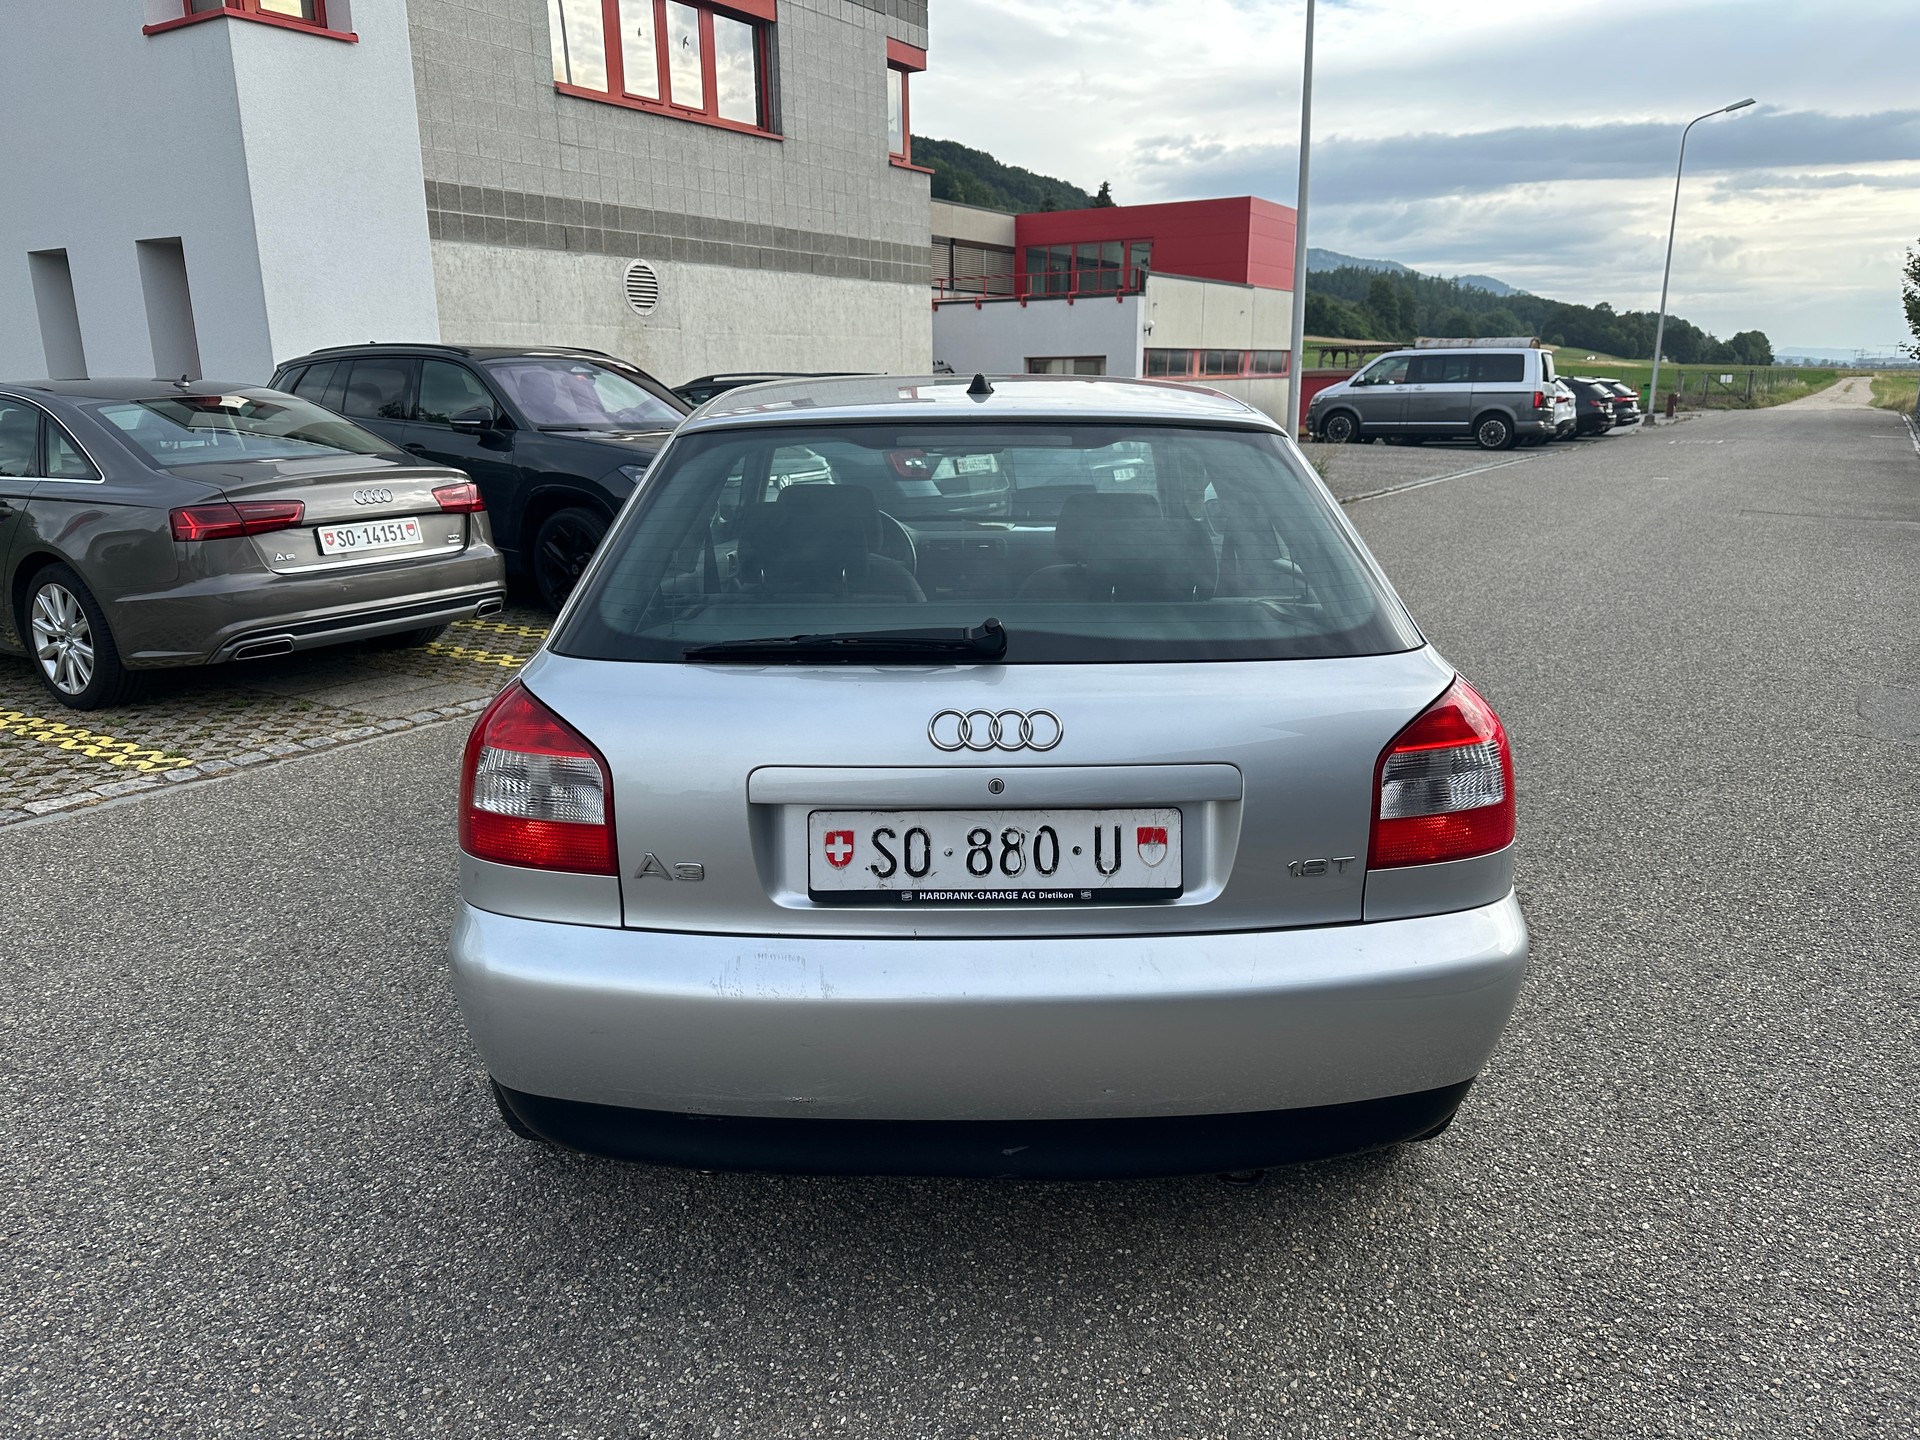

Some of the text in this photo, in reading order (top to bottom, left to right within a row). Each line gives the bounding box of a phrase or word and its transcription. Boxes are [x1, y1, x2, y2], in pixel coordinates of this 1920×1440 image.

[634, 852, 704, 881] A3
[919, 891, 1074, 900] HARDRANK-GARAGE AG Dietikon
